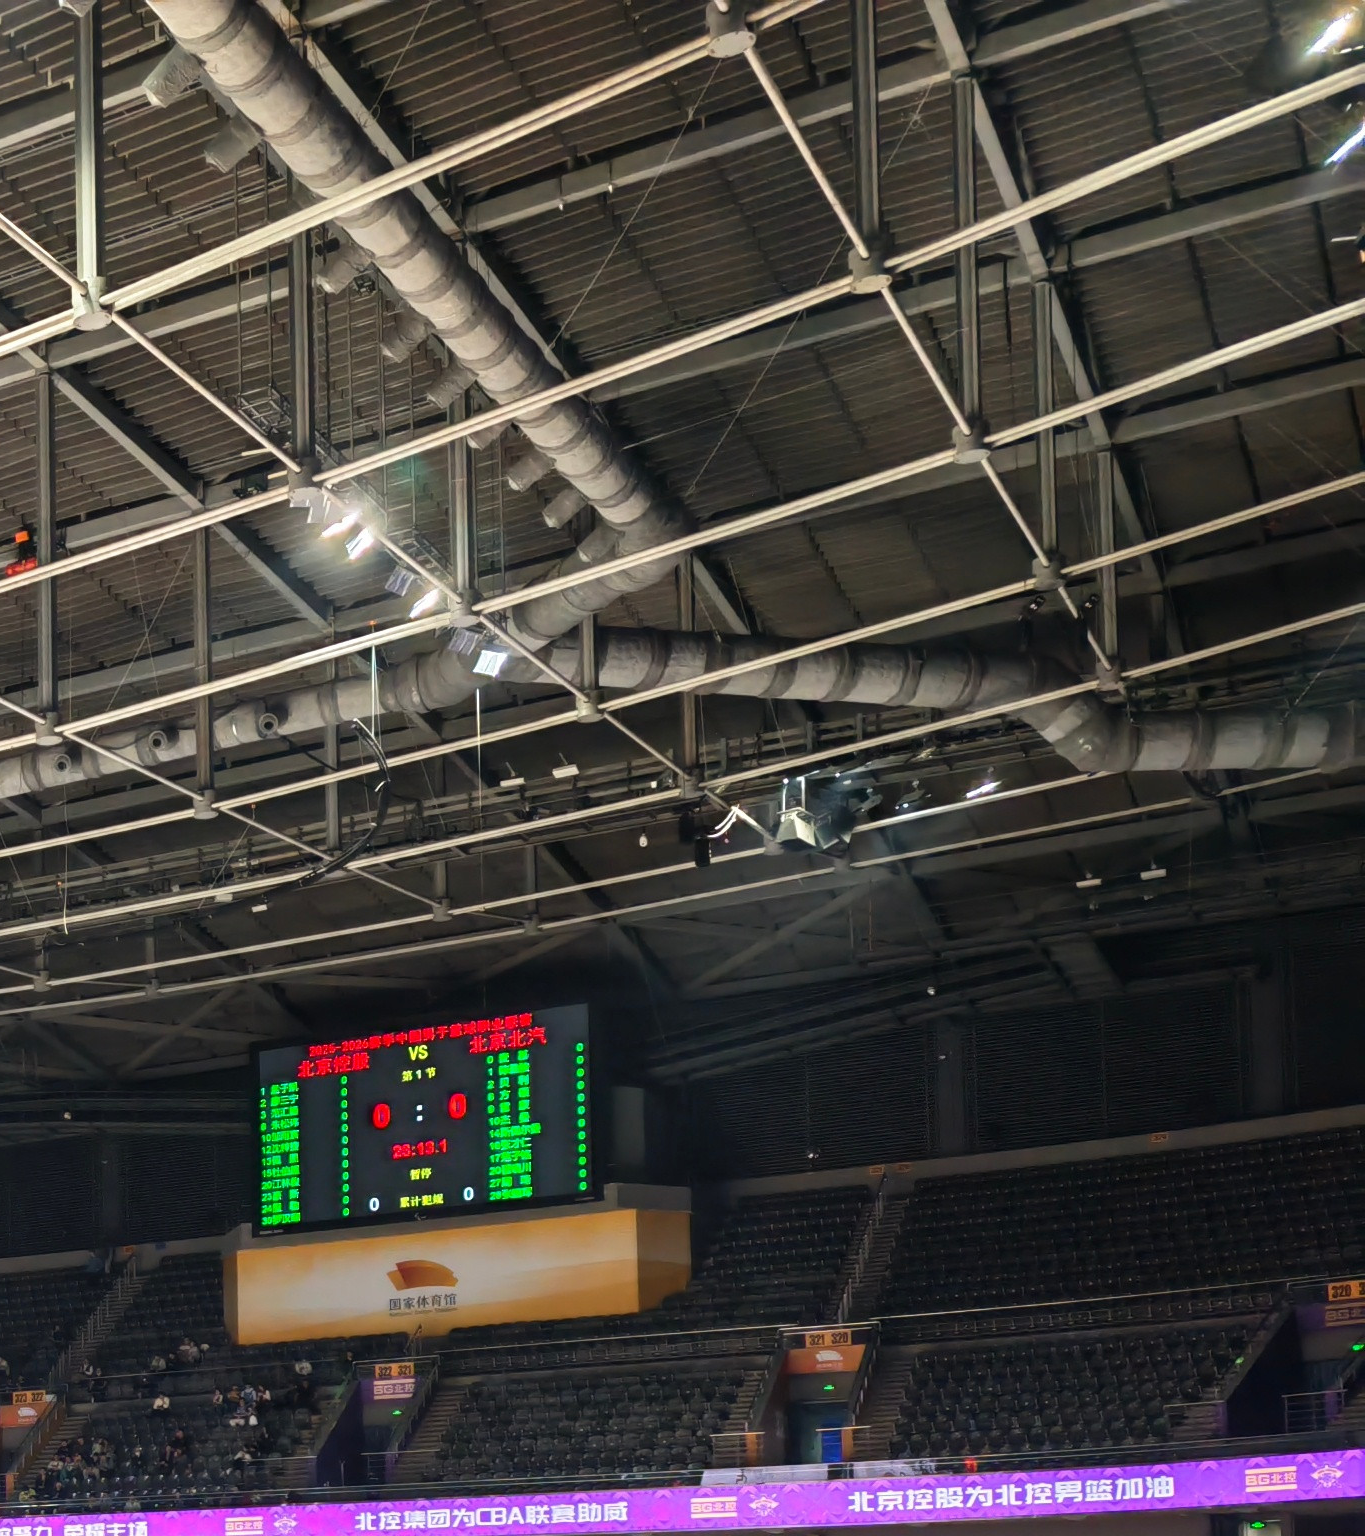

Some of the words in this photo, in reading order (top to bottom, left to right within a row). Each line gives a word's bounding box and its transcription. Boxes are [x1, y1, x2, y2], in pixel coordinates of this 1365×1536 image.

[408, 1045, 429, 1061] VS
[469, 1027, 548, 1054] 北京北汽
[297, 1053, 370, 1078] 北京控股
[372, 1103, 391, 1129] 0
[449, 1093, 467, 1119] 0
[369, 1197, 380, 1212] 0
[463, 1186, 475, 1201] 0
[390, 1293, 457, 1310] 国家体育馆
[1332, 1284, 1351, 1299] 320
[810, 1334, 825, 1346] 321
[831, 1332, 849, 1345] 320
[378, 1366, 392, 1377] 322
[397, 1365, 412, 1376] 321
[849, 1475, 1174, 1512] 北京控股为北控男篮加油
[356, 1502, 628, 1530] 北控集团为CBA联赛助威
